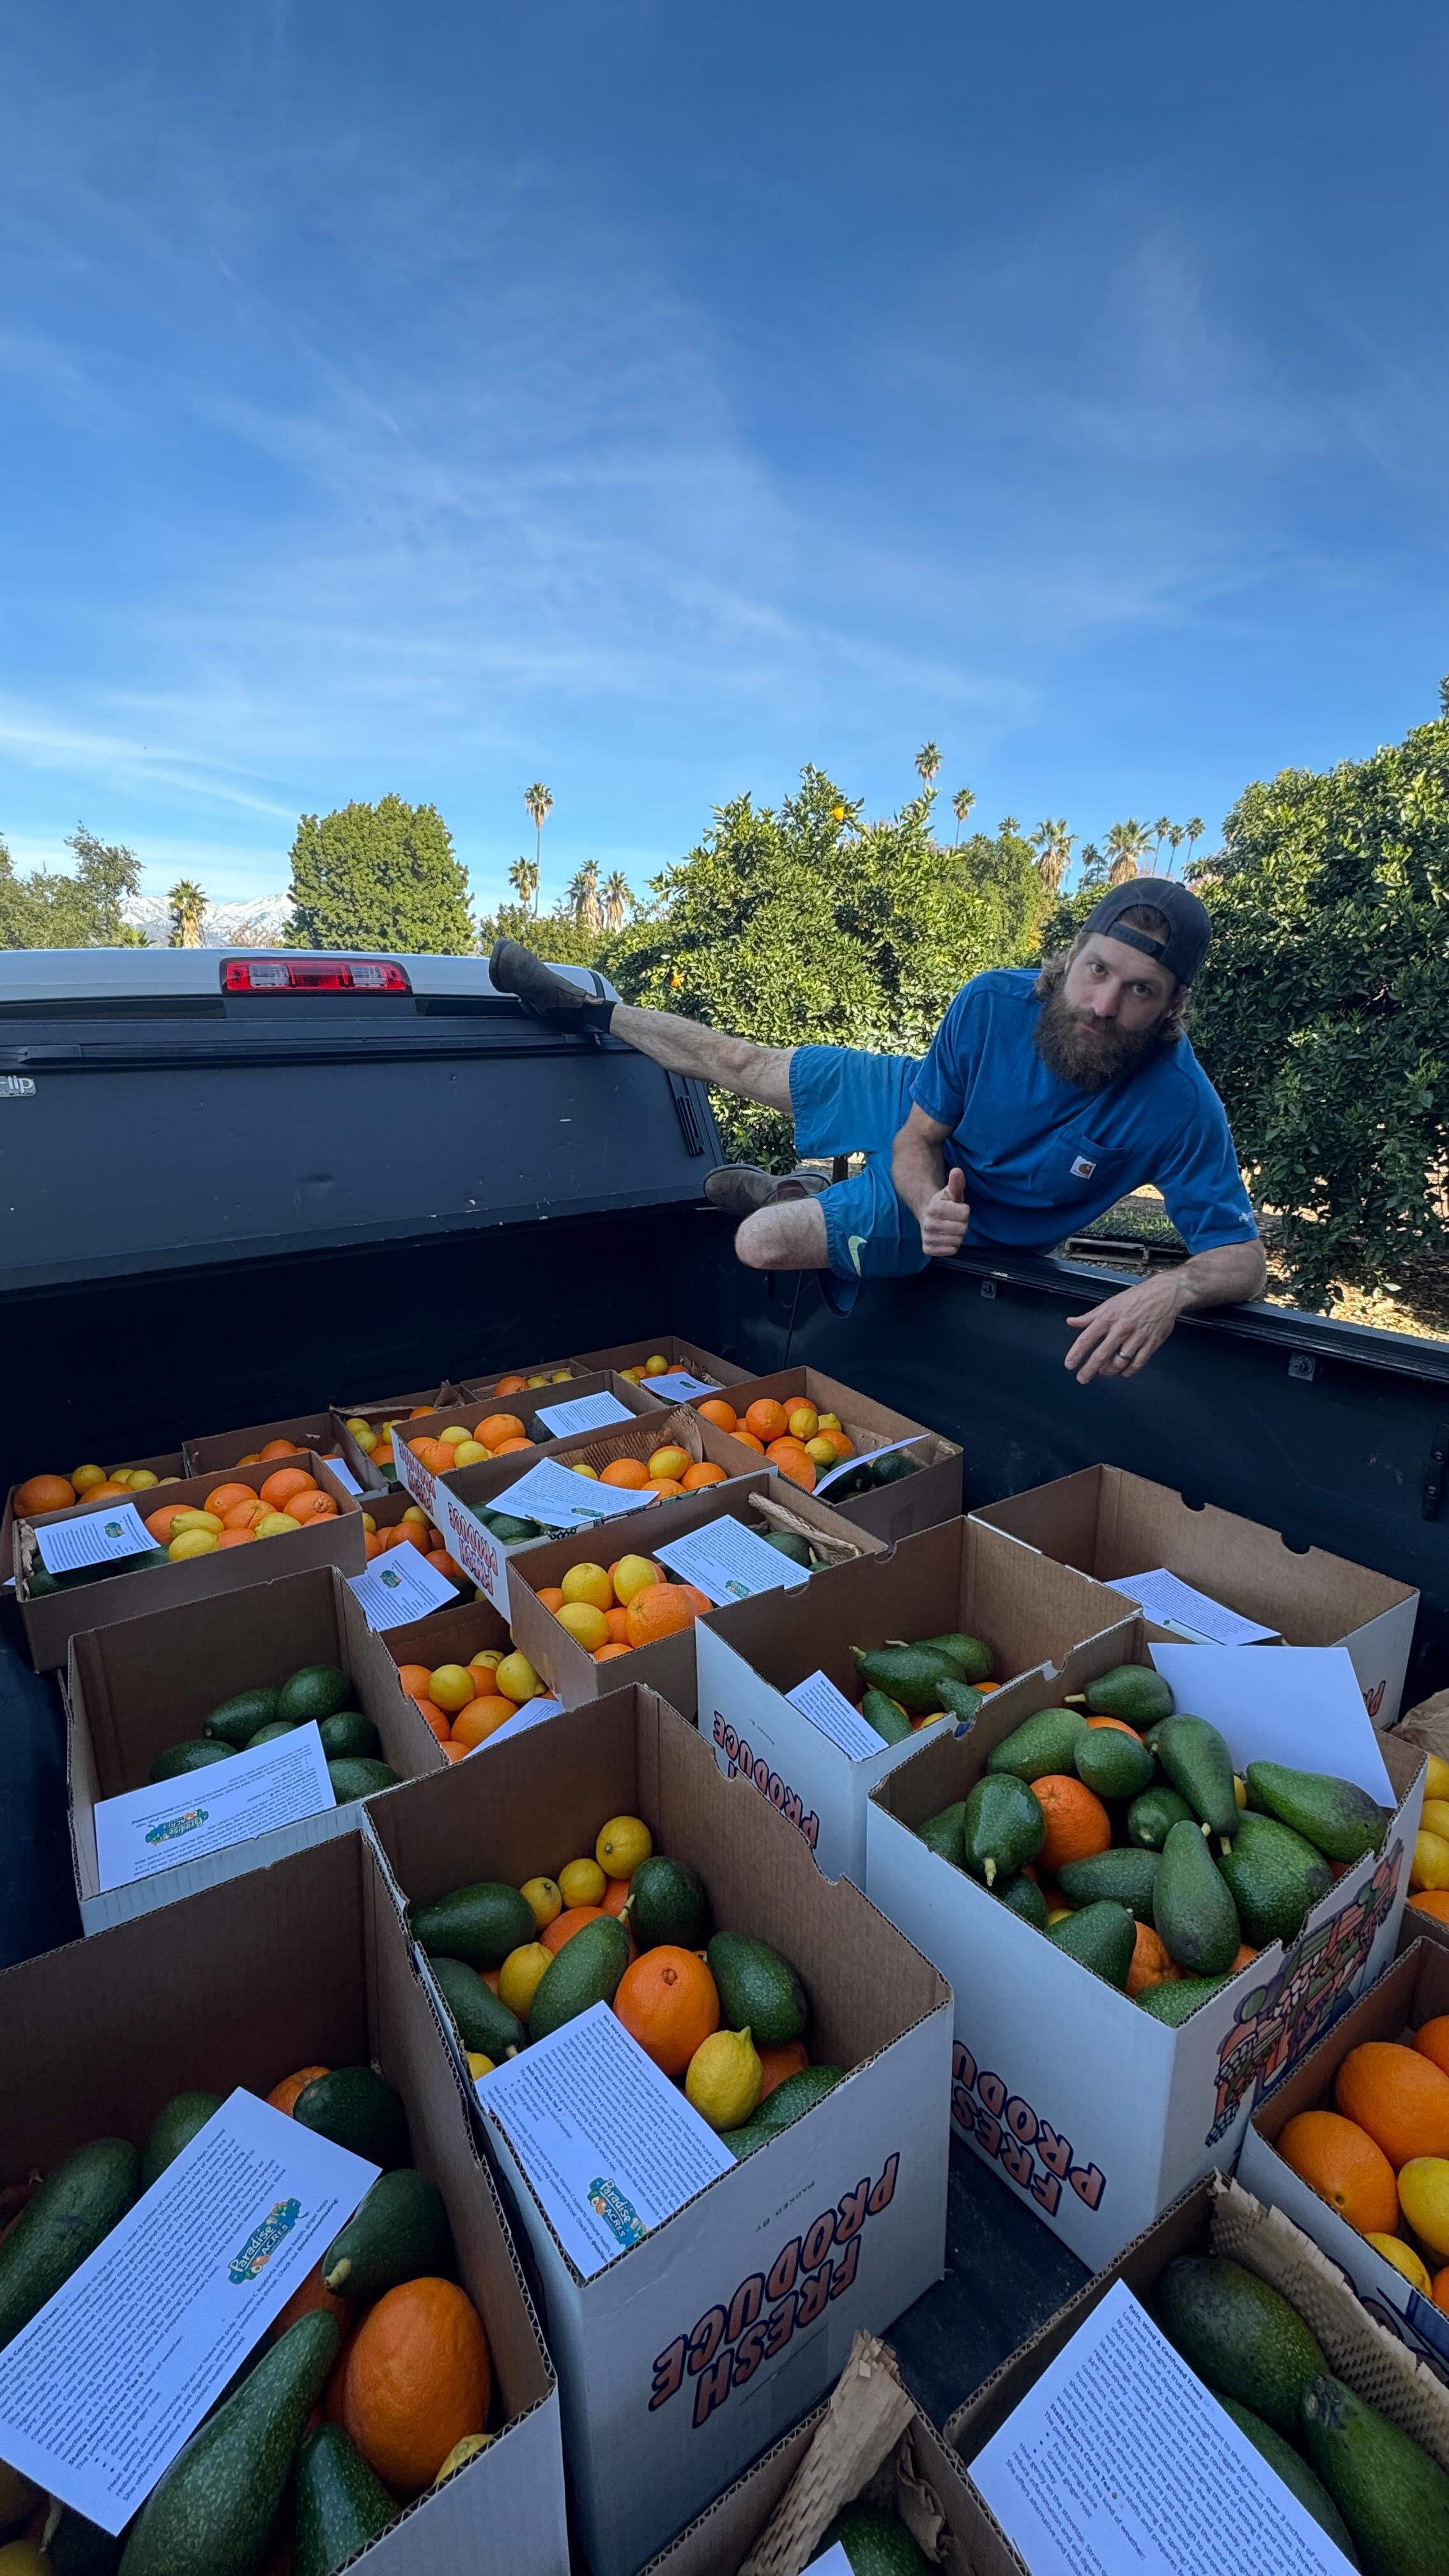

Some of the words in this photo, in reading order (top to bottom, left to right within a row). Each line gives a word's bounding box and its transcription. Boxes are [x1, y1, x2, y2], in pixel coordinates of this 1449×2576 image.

[448, 1501, 498, 1577] PRODUCE
[713, 1710, 820, 1849] PRODUCE
[950, 2085, 1062, 2217] FRES
[952, 2039, 1107, 2211] PRODU
[229, 2226, 274, 2273] Paradise
[261, 2224, 288, 2256] ACRES
[600, 2179, 631, 2223] Paradise
[604, 2209, 625, 2237] ACRES
[648, 2152, 900, 2411] PRODUCE
[692, 2234, 861, 2428] FRESH
[1142, 2320, 1158, 2340] Wind
[1161, 2345, 1188, 2379] Confused
[1186, 2378, 1203, 2399] Trees
[1039, 2458, 1056, 2485] Honey
[1043, 2410, 1054, 2425] The
[1052, 2426, 1072, 2451] perfect
[1070, 2450, 1085, 2471] drink
[1084, 2470, 1092, 2482] for
[1091, 2481, 1102, 2497] this
[1114, 2515, 1122, 2524] of
[1046, 2450, 1065, 2476] Grated
[1080, 2501, 1093, 2518] root
[1050, 2402, 1065, 2425] Stella
[1064, 2424, 1084, 2452] Moon's
[1083, 2451, 1100, 2476] Citrus
[1100, 2476, 1110, 2492] Tea
[1052, 2442, 1069, 2464] Fresh
[1066, 2464, 1085, 2490] orange
[1083, 2488, 1098, 2509] juice
[1056, 2396, 1078, 2428] watching
[1078, 2427, 1094, 2452] closely
[1094, 2451, 1101, 2460] as
[1100, 2460, 1110, 2474] the
[1108, 2474, 1125, 2496] grove
[1124, 2496, 1140, 2517] shifts
[1140, 2518, 1153, 2533] and
[1150, 2534, 1178, 2569] prepares
[1100, 2375, 1112, 2388] and
[1110, 2388, 1119, 2400] our
[1119, 2401, 1133, 2418] wind
[1132, 2418, 1158, 2452] machines
[1157, 2452, 1193, 2502] automatically
[1193, 2500, 1215, 2528] turned
[1213, 2529, 1222, 2540] on
[1107, 2400, 1121, 2417] Cold
[1126, 2428, 1144, 2451] settles
[1144, 2451, 1157, 2468] near
[1157, 2467, 1167, 2482] the
[1189, 2513, 1202, 2529] and
[1200, 2528, 1211, 2543] the
[1211, 2544, 1227, 2564] wind
[1111, 2327, 1126, 2344] short
[1164, 2395, 1187, 2426] because
[1186, 2426, 1195, 2437] we
[1195, 2436, 1209, 2457] keep
[1209, 2456, 1225, 2476] cover
[1225, 2477, 1239, 2496] crop
[1238, 2496, 1264, 2528] growing
[1264, 2527, 1278, 2543] and
[1276, 2543, 1298, 2569] mulch
[1122, 2310, 1135, 2326] Last
[1133, 2326, 1147, 2343] week
[1146, 2342, 1168, 2368] brought
[1170, 2373, 1183, 2389] true
[1183, 2389, 1200, 2411] winter
[1200, 2412, 1225, 2441] moment
[1223, 2441, 1231, 2451] to
[1230, 2450, 1241, 2464] the
[1240, 2465, 1258, 2486] grove
[1266, 2497, 1279, 2513] over
[1285, 2520, 1306, 2548] inches
[1306, 2548, 1315, 2557] of
[1314, 2558, 1328, 2576] rain
